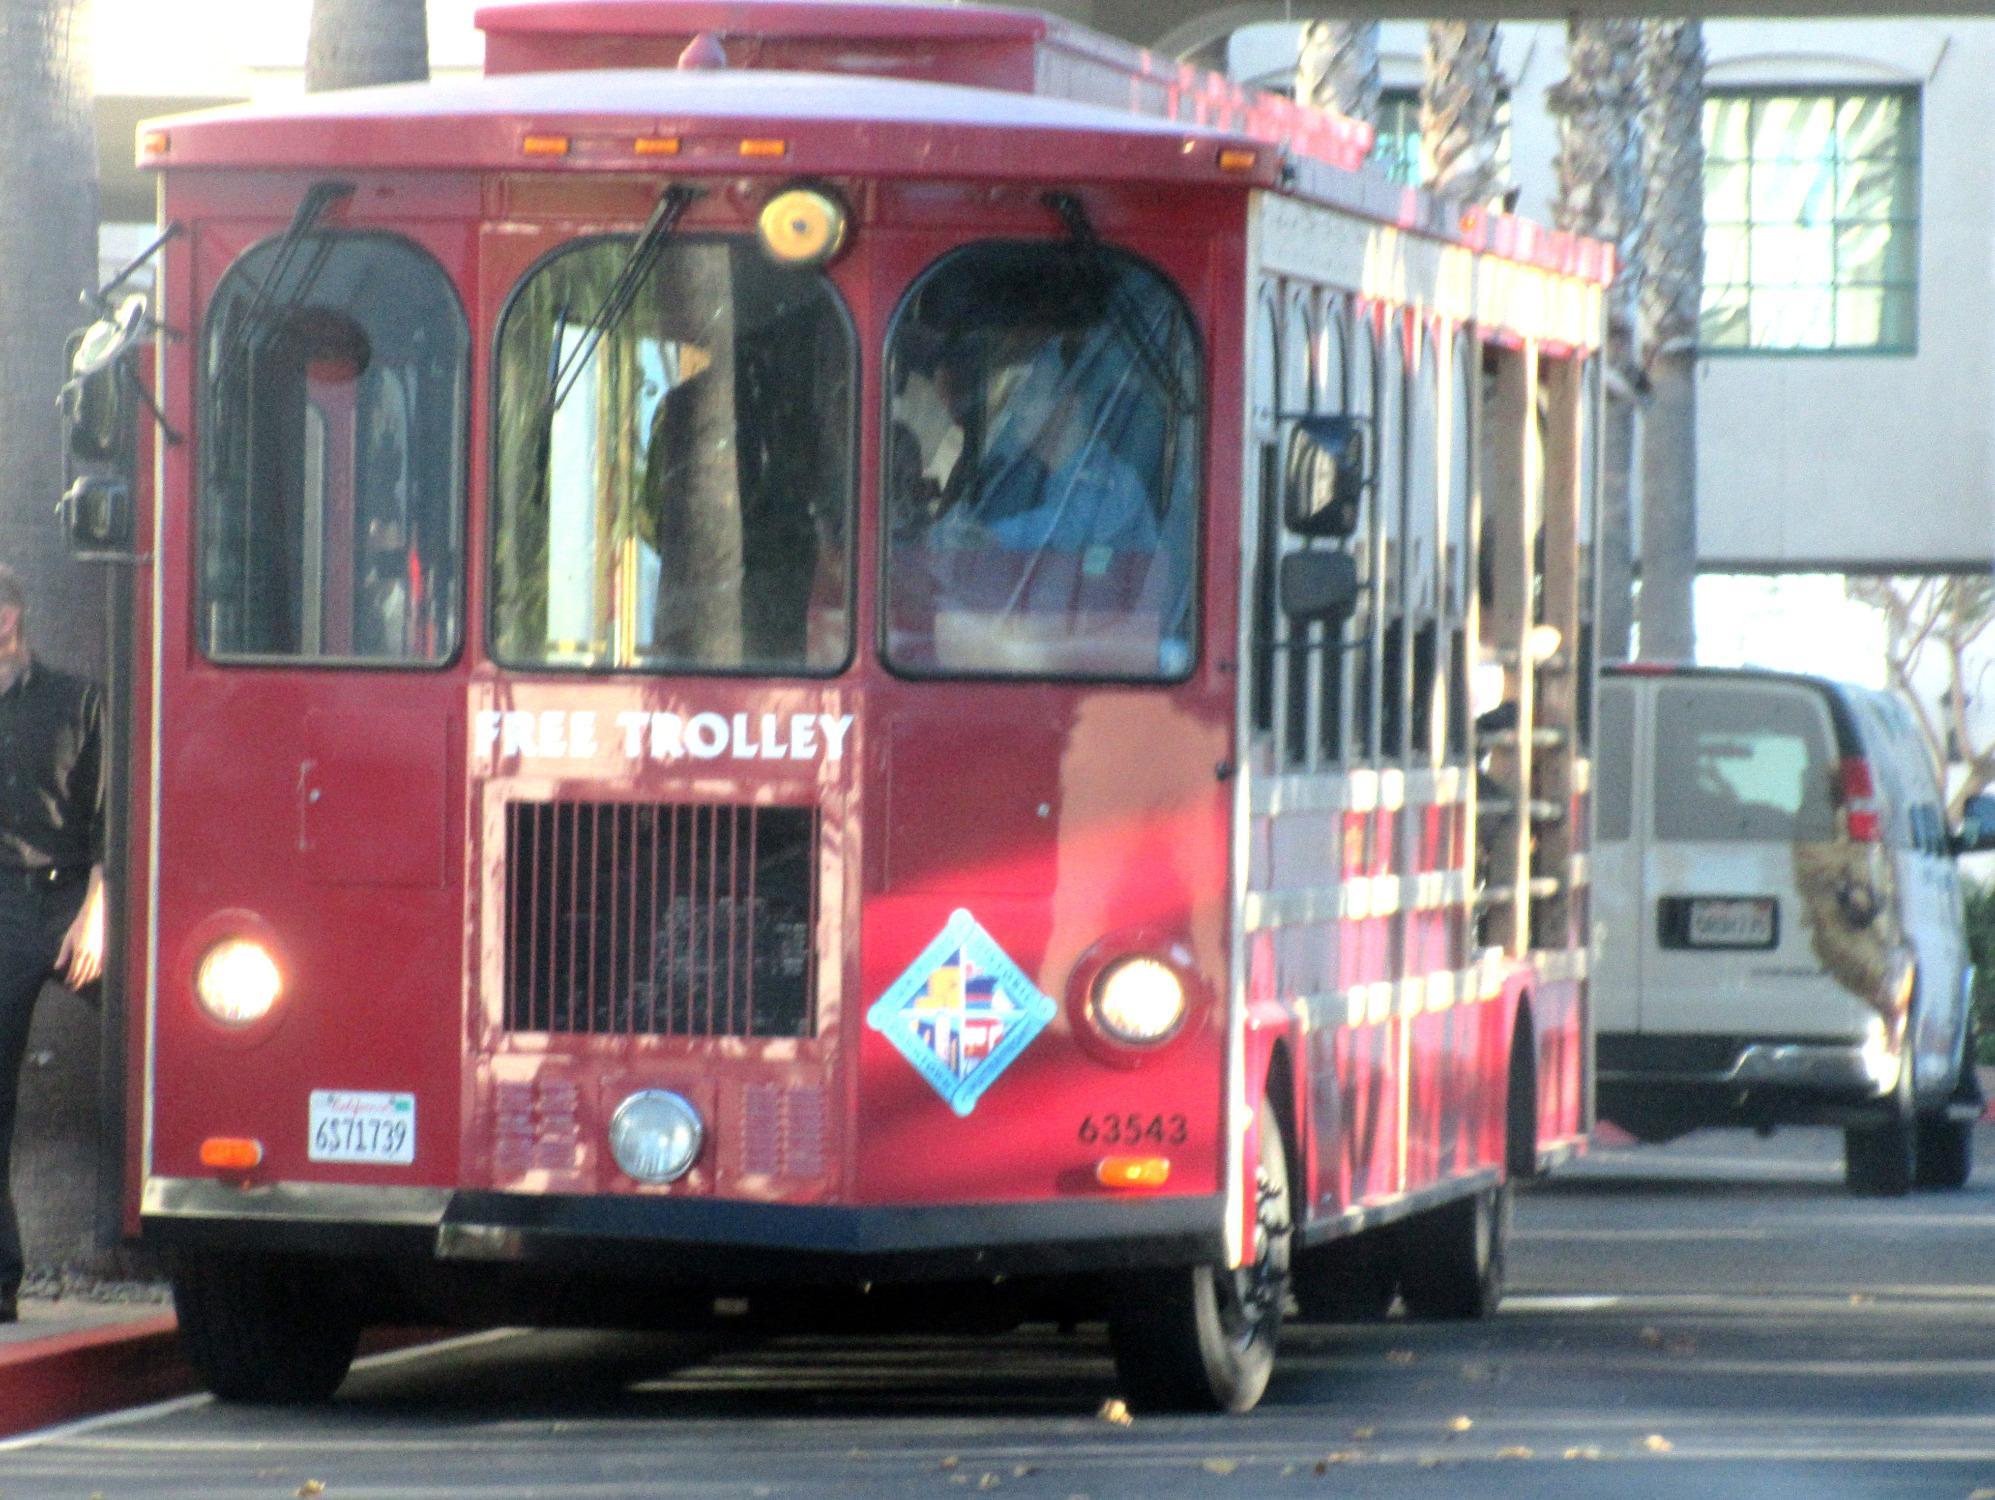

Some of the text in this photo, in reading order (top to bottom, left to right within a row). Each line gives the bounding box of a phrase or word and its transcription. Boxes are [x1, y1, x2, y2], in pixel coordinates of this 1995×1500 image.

[474, 710, 854, 761] FREE TROLLEY
[1078, 1113, 1188, 1145] 63543
